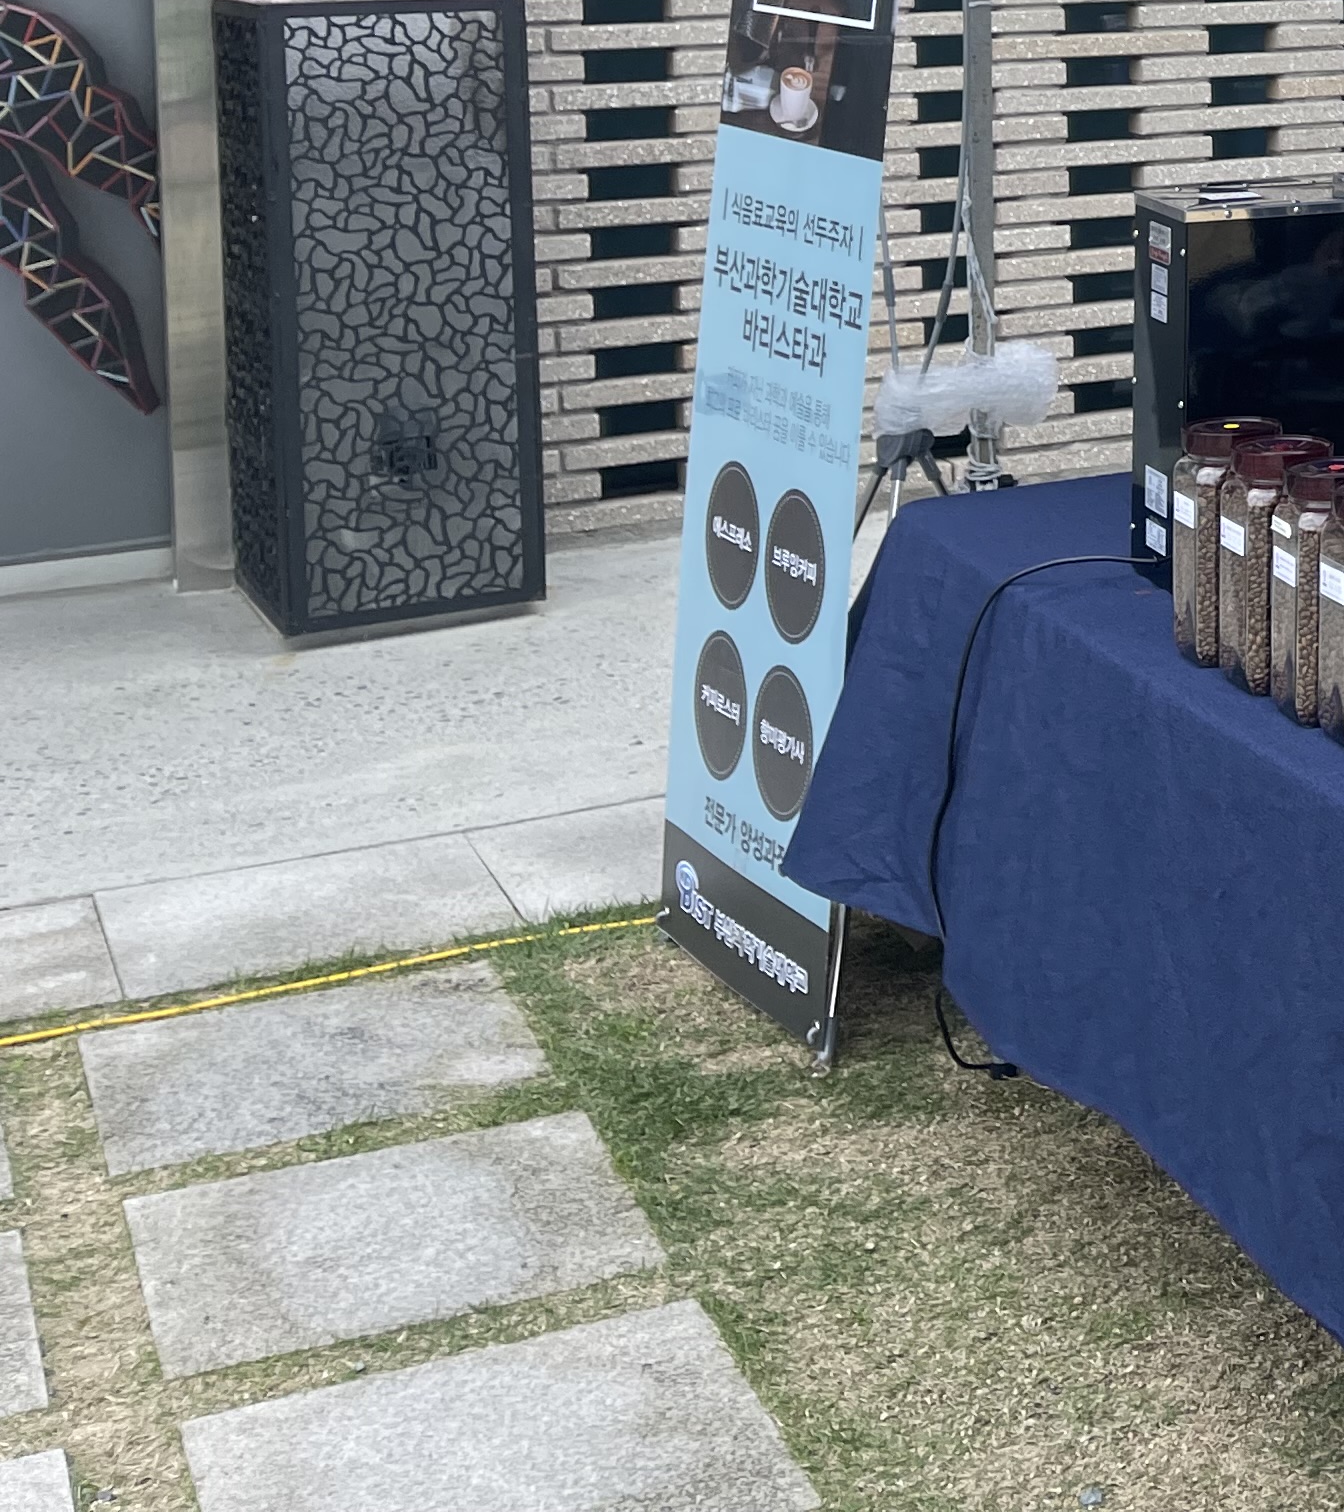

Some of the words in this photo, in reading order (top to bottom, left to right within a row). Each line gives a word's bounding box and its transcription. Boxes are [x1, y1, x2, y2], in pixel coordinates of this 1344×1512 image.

[731, 191, 800, 241] 식음료교육의
[802, 212, 854, 259] 선두주자
[713, 244, 864, 331] 부산과학기술대학교
[742, 308, 828, 378] 바리스타과
[705, 795, 737, 845] 전문가
